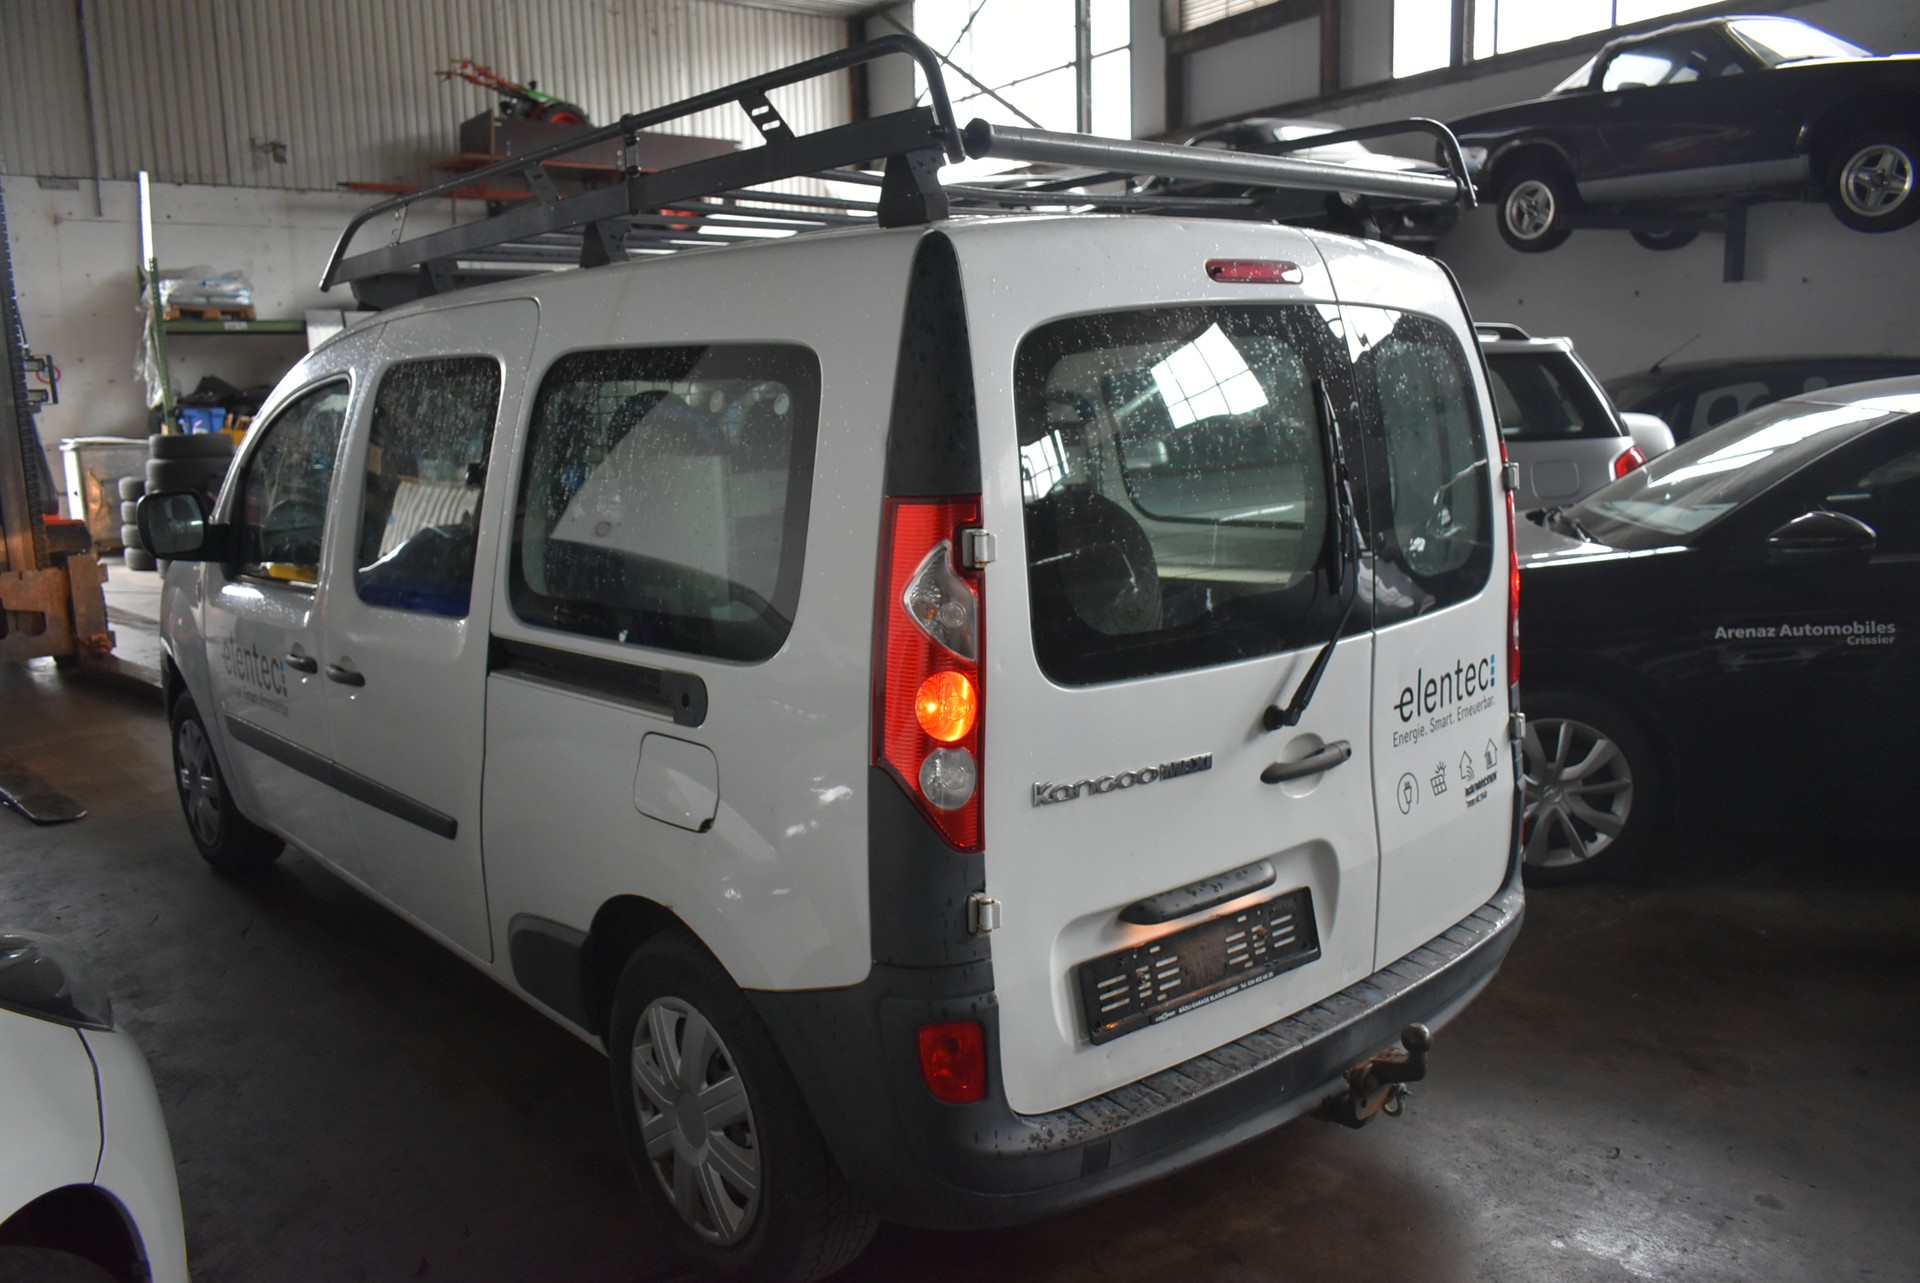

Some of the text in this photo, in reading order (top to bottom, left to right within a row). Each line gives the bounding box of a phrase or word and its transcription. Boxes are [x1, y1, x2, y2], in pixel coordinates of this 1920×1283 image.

[1715, 620, 1896, 640] Arenaz Automobiles
[1846, 634, 1896, 646] Crissier
[221, 632, 281, 695] elentec
[1393, 723, 1428, 748] Energie.
[1429, 712, 1456, 734] Smart.
